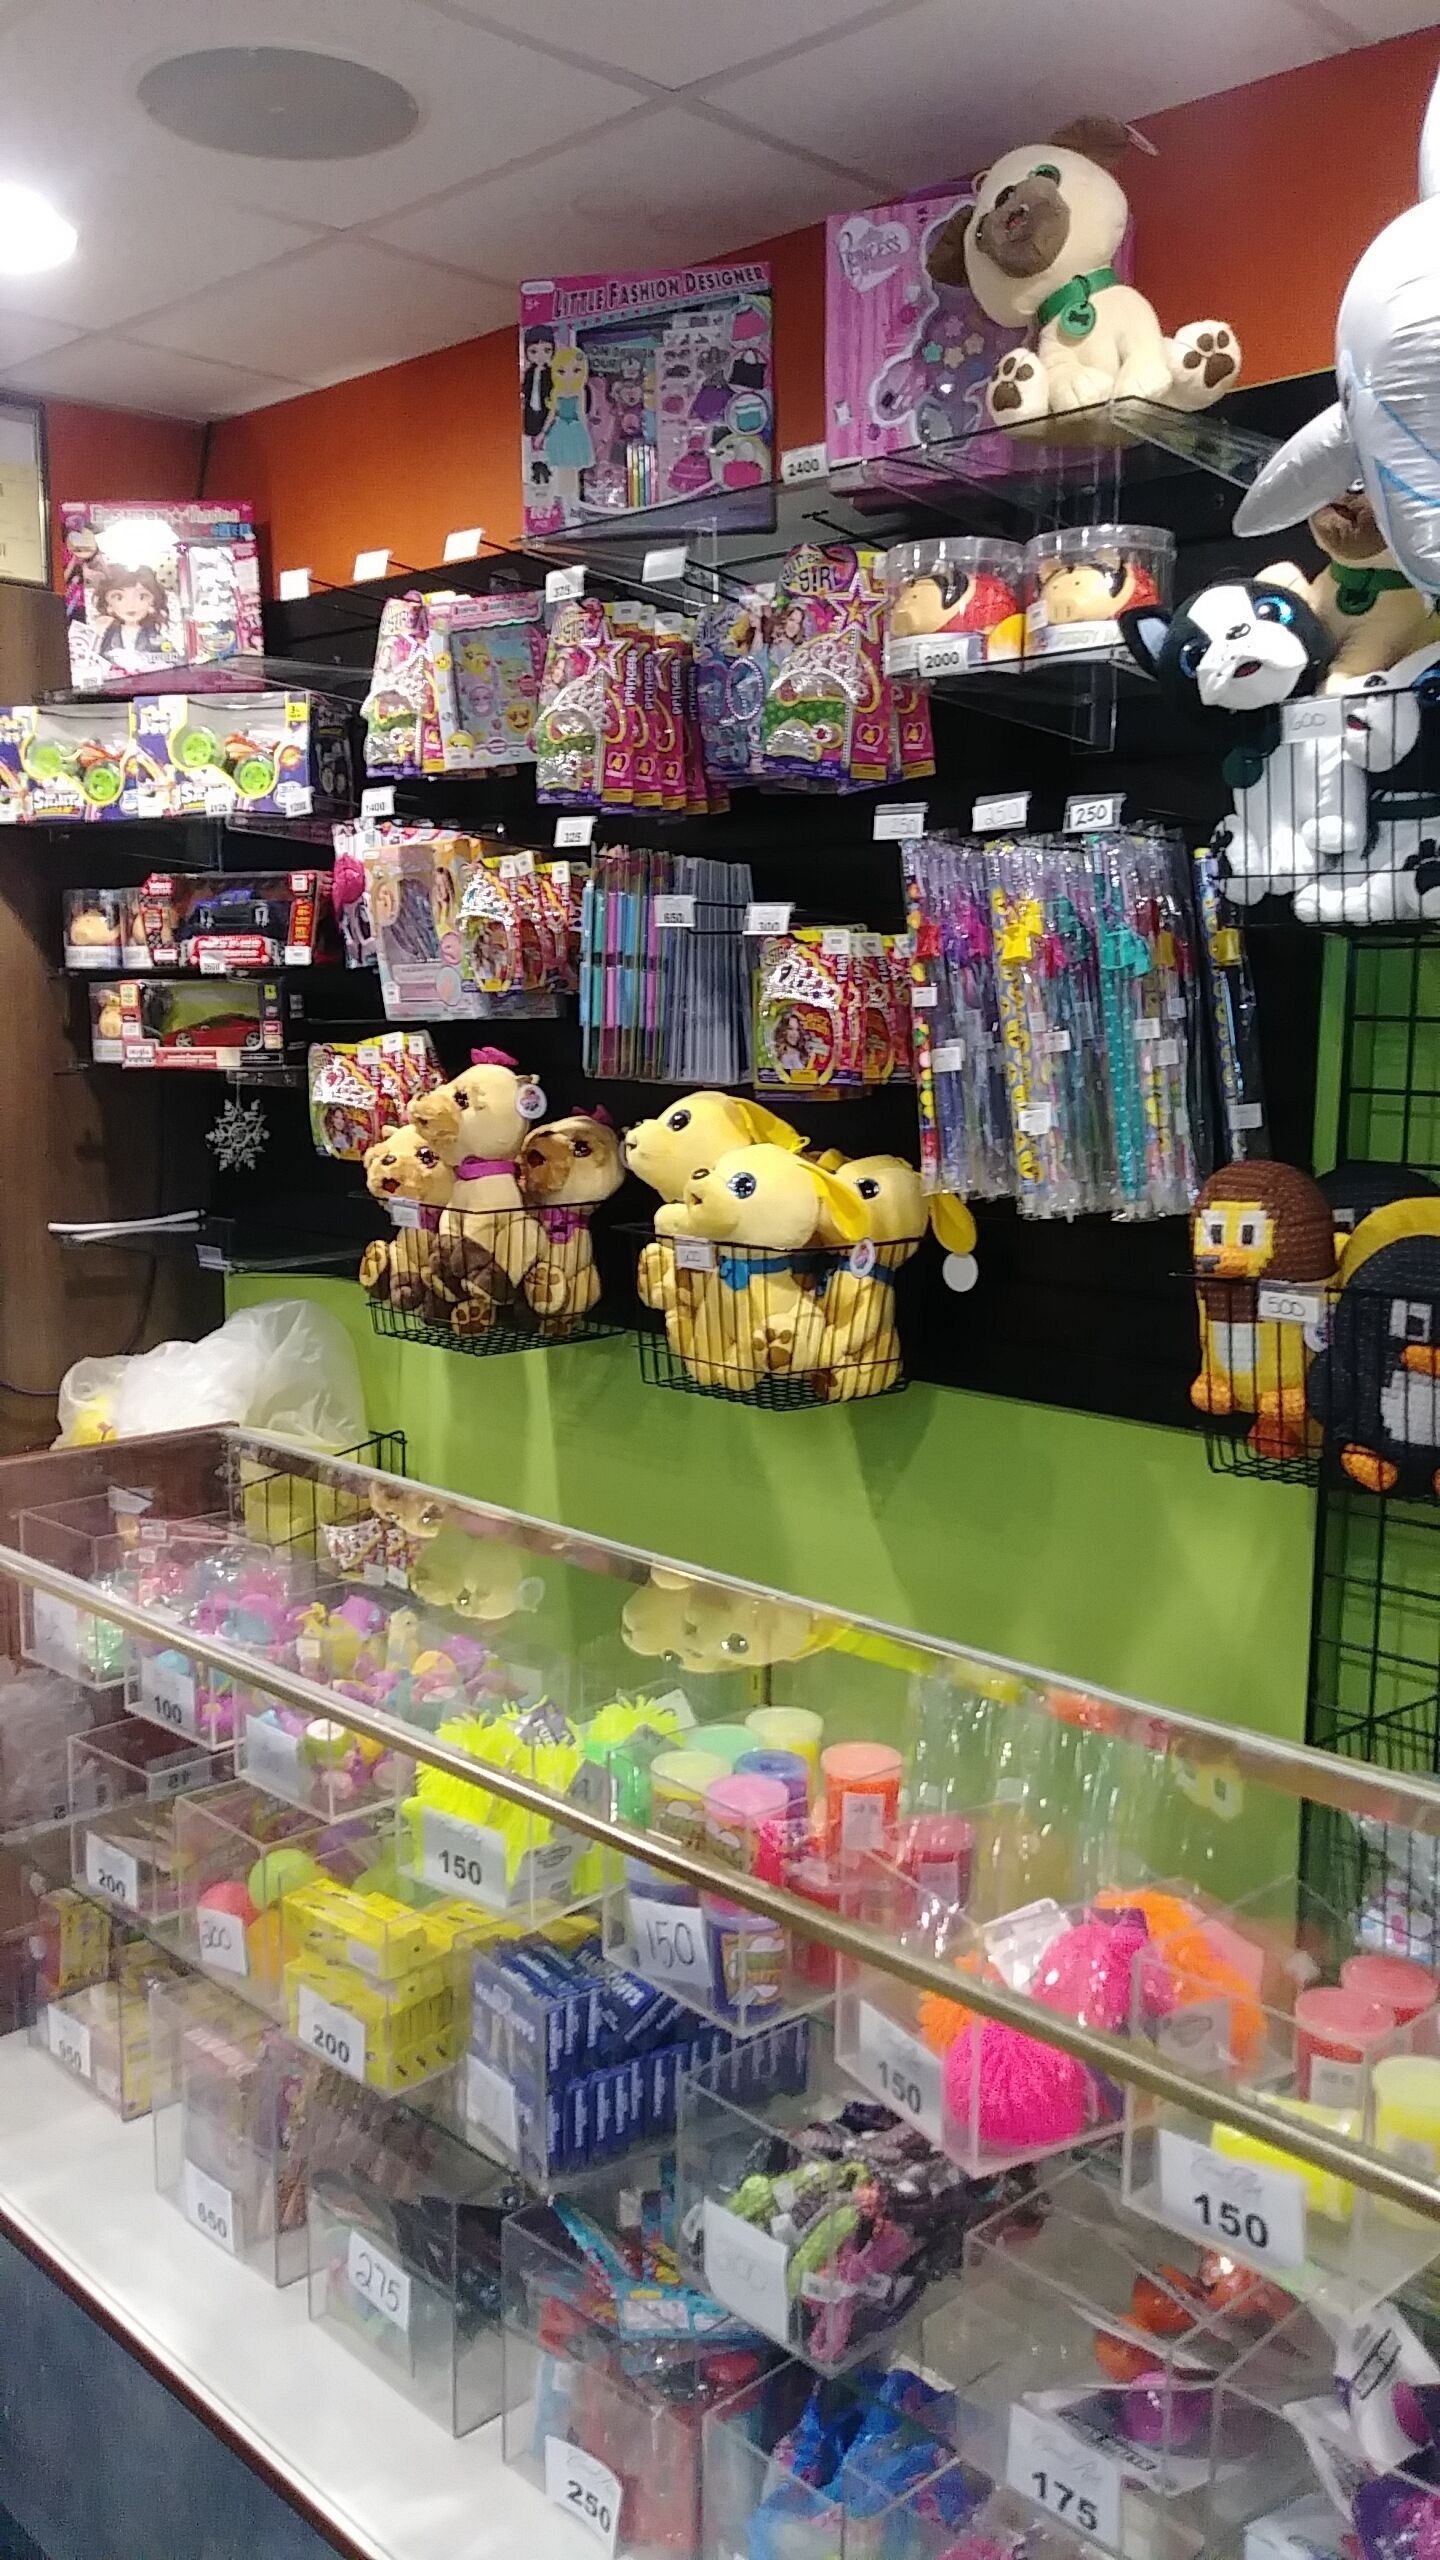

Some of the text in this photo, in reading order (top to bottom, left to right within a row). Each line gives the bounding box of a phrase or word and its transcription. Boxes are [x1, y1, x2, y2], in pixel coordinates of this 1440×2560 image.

[553, 265, 765, 318] LITTLE FASHION DESIGNER
[787, 457, 820, 477] 2400
[924, 650, 960, 670] 2000
[1075, 804, 1108, 826] 250
[154, 1695, 182, 1723] 100
[98, 1867, 125, 1898] 200
[438, 1848, 482, 1886] 150
[645, 1919, 696, 1969] 150
[313, 2023, 350, 2064] 200
[878, 2060, 921, 2115] 150
[1194, 2193, 1269, 2249] 150
[355, 2252, 400, 2312] 275
[567, 2480, 611, 2534] 250
[1031, 2471, 1098, 2532] 175
